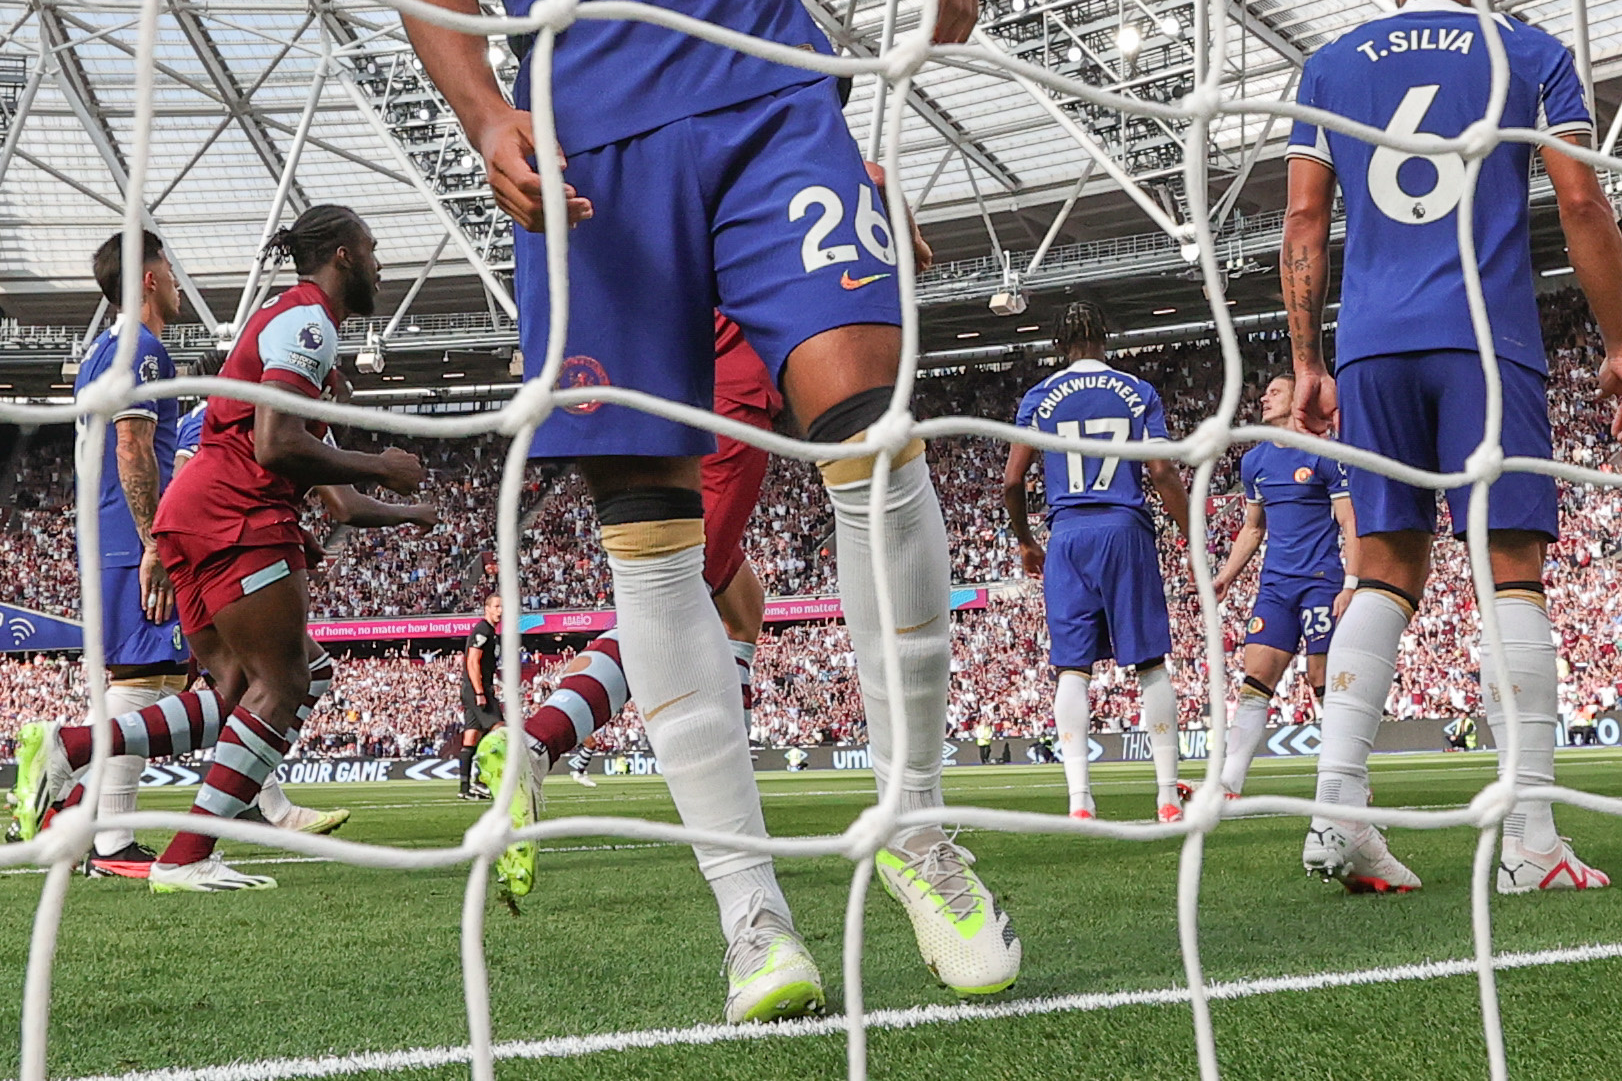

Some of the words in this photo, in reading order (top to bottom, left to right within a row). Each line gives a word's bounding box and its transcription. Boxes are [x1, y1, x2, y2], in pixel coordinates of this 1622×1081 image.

[1367, 84, 1466, 225] 6
[788, 183, 897, 274] 26
[1037, 375, 1146, 419] CHUKWUEMEKA
[1057, 417, 1130, 494] 17
[804, 603, 839, 613] matter
[1302, 606, 1331, 639] 23
[315, 626, 325, 637] of
[326, 627, 357, 637] home,
[357, 626, 371, 635] no
[372, 624, 407, 635] matter
[407, 623, 429, 634] how
[429, 622, 452, 634] long
[452, 622, 471, 633] you
[1121, 732, 1153, 760] THIS
[290, 762, 333, 784] OUR
[335, 761, 391, 783] GAME
